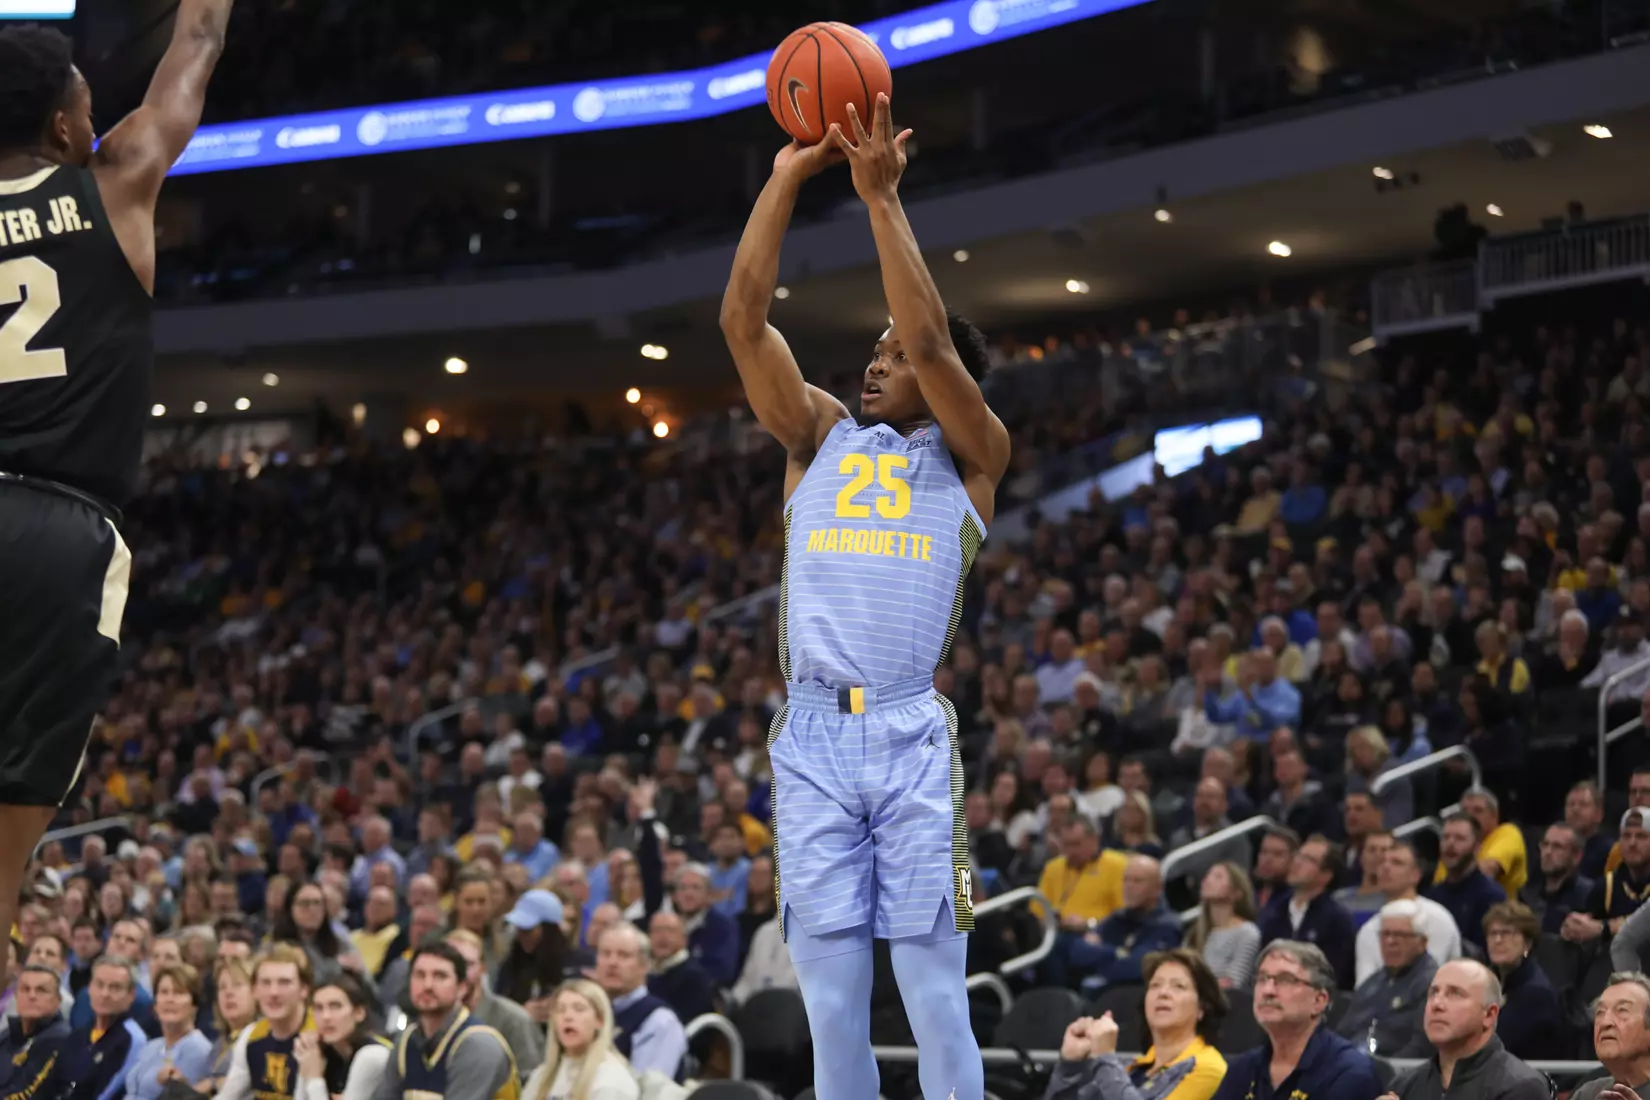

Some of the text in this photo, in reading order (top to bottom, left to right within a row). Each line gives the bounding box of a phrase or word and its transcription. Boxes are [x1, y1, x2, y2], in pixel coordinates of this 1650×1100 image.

[46, 195, 93, 235] JR.
[0, 255, 67, 383] 2
[836, 454, 911, 519] 25
[807, 529, 932, 561] MARQUETTE
